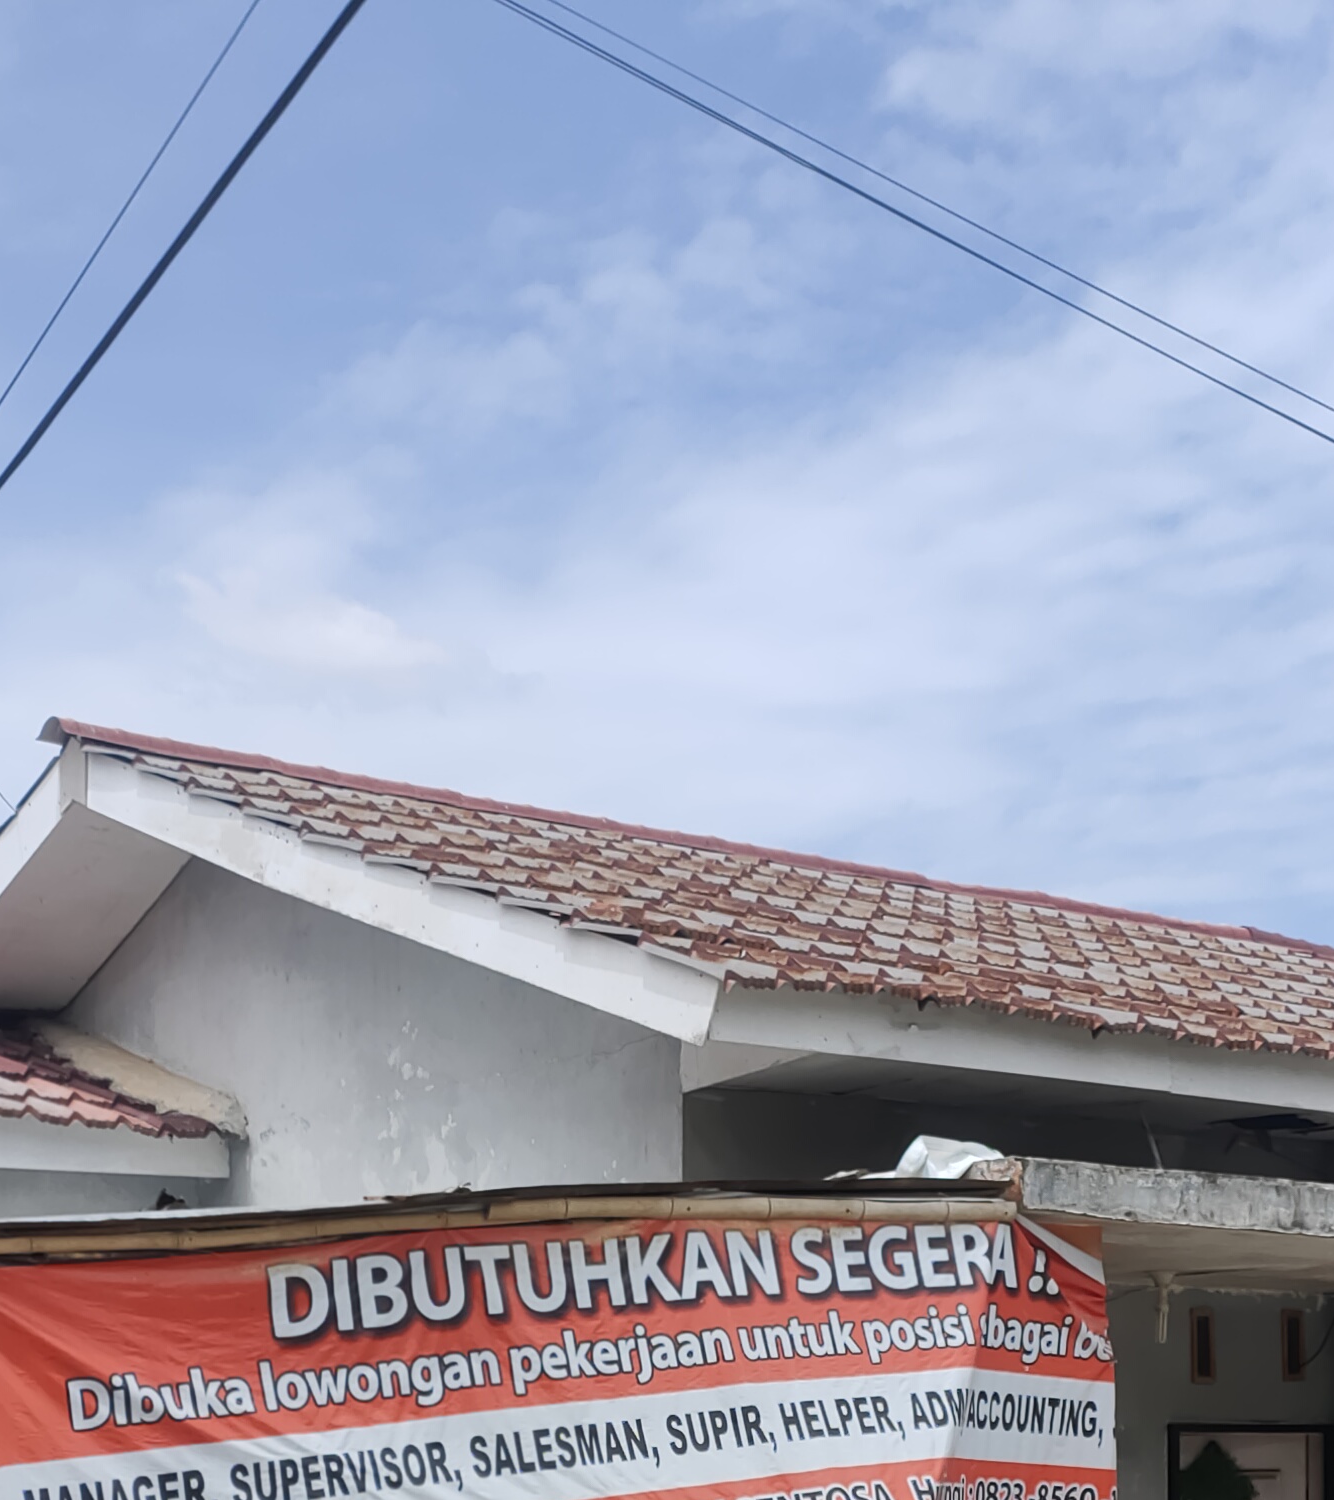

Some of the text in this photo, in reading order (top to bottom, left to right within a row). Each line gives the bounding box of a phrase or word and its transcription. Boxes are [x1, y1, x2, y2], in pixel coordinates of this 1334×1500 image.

[267, 1230, 782, 1341] DIBUTUHKAN
[790, 1223, 1018, 1297] SEGERA
[67, 1367, 254, 1432] Dibuka
[259, 1349, 501, 1413] lowongan
[509, 1323, 735, 1396] pekerjaan
[740, 1309, 860, 1361] untuk
[863, 1304, 975, 1364] posisi
[468, 1418, 661, 1482] SALESMAN,
[669, 1404, 778, 1458] SUPIR,
[782, 1394, 906, 1443] HELPER,
